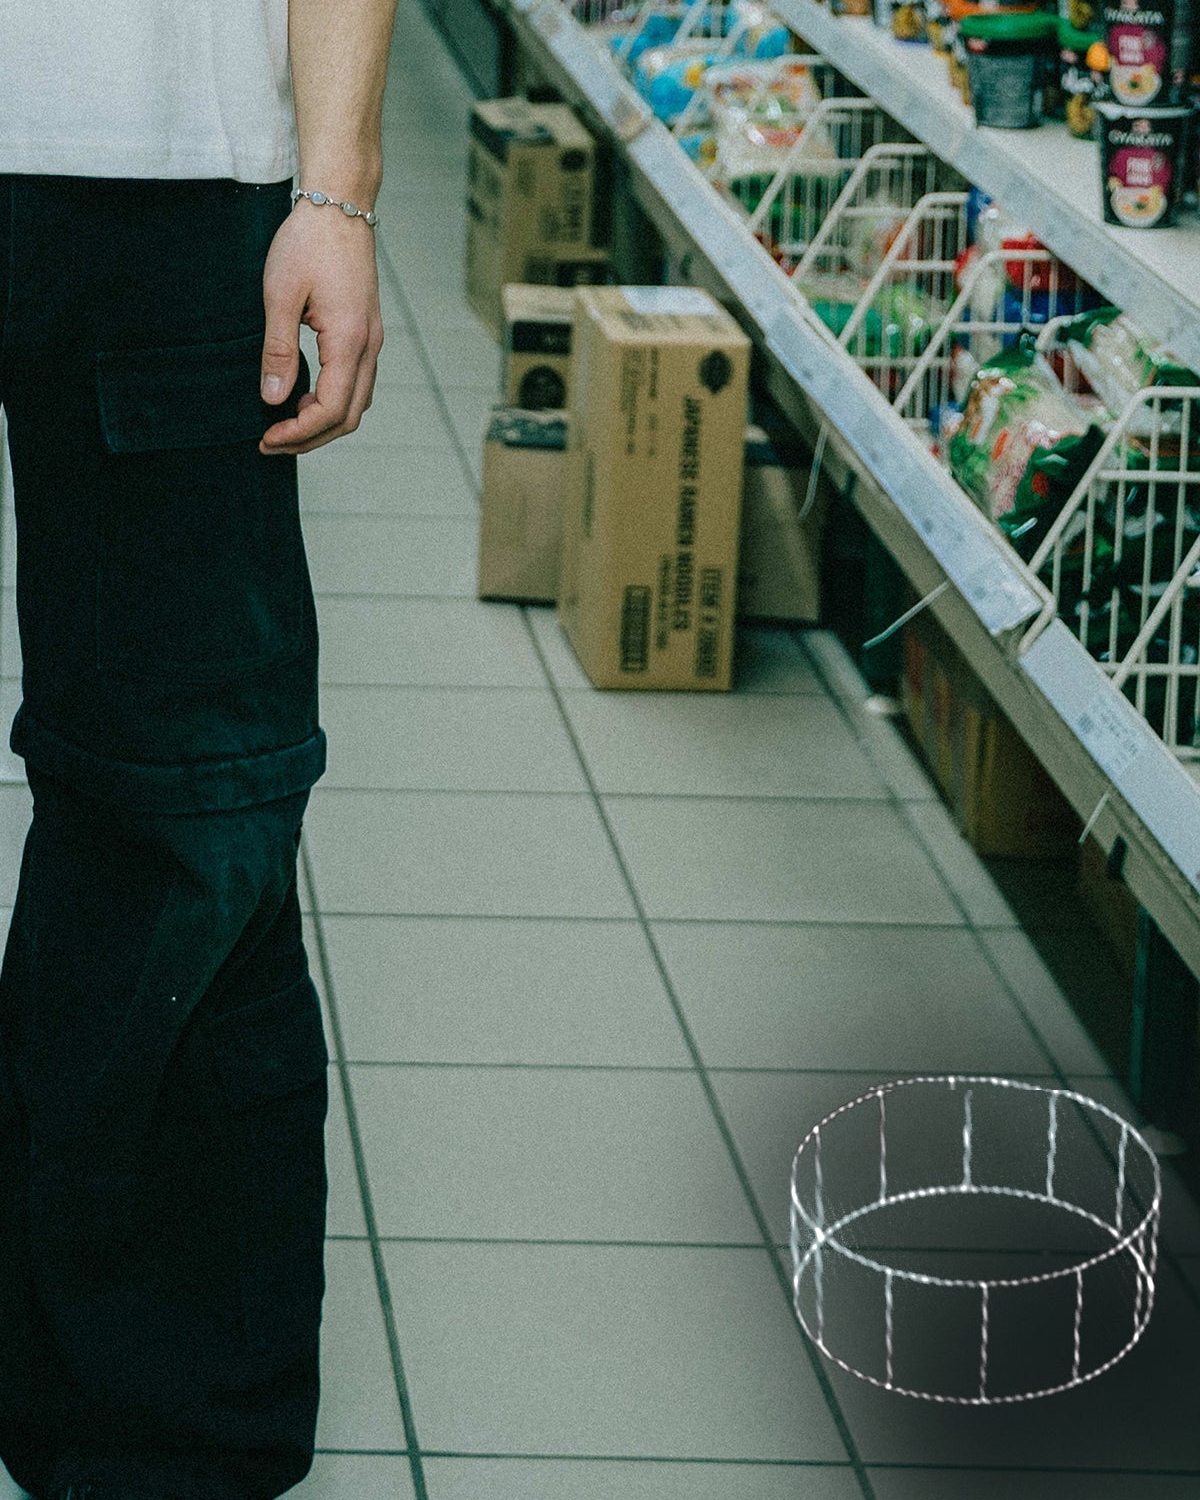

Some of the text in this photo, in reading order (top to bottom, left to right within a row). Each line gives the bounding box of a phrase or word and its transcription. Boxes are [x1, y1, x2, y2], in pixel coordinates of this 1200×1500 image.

[672, 396, 701, 633] JAPANESE RAMEN NOODLES
